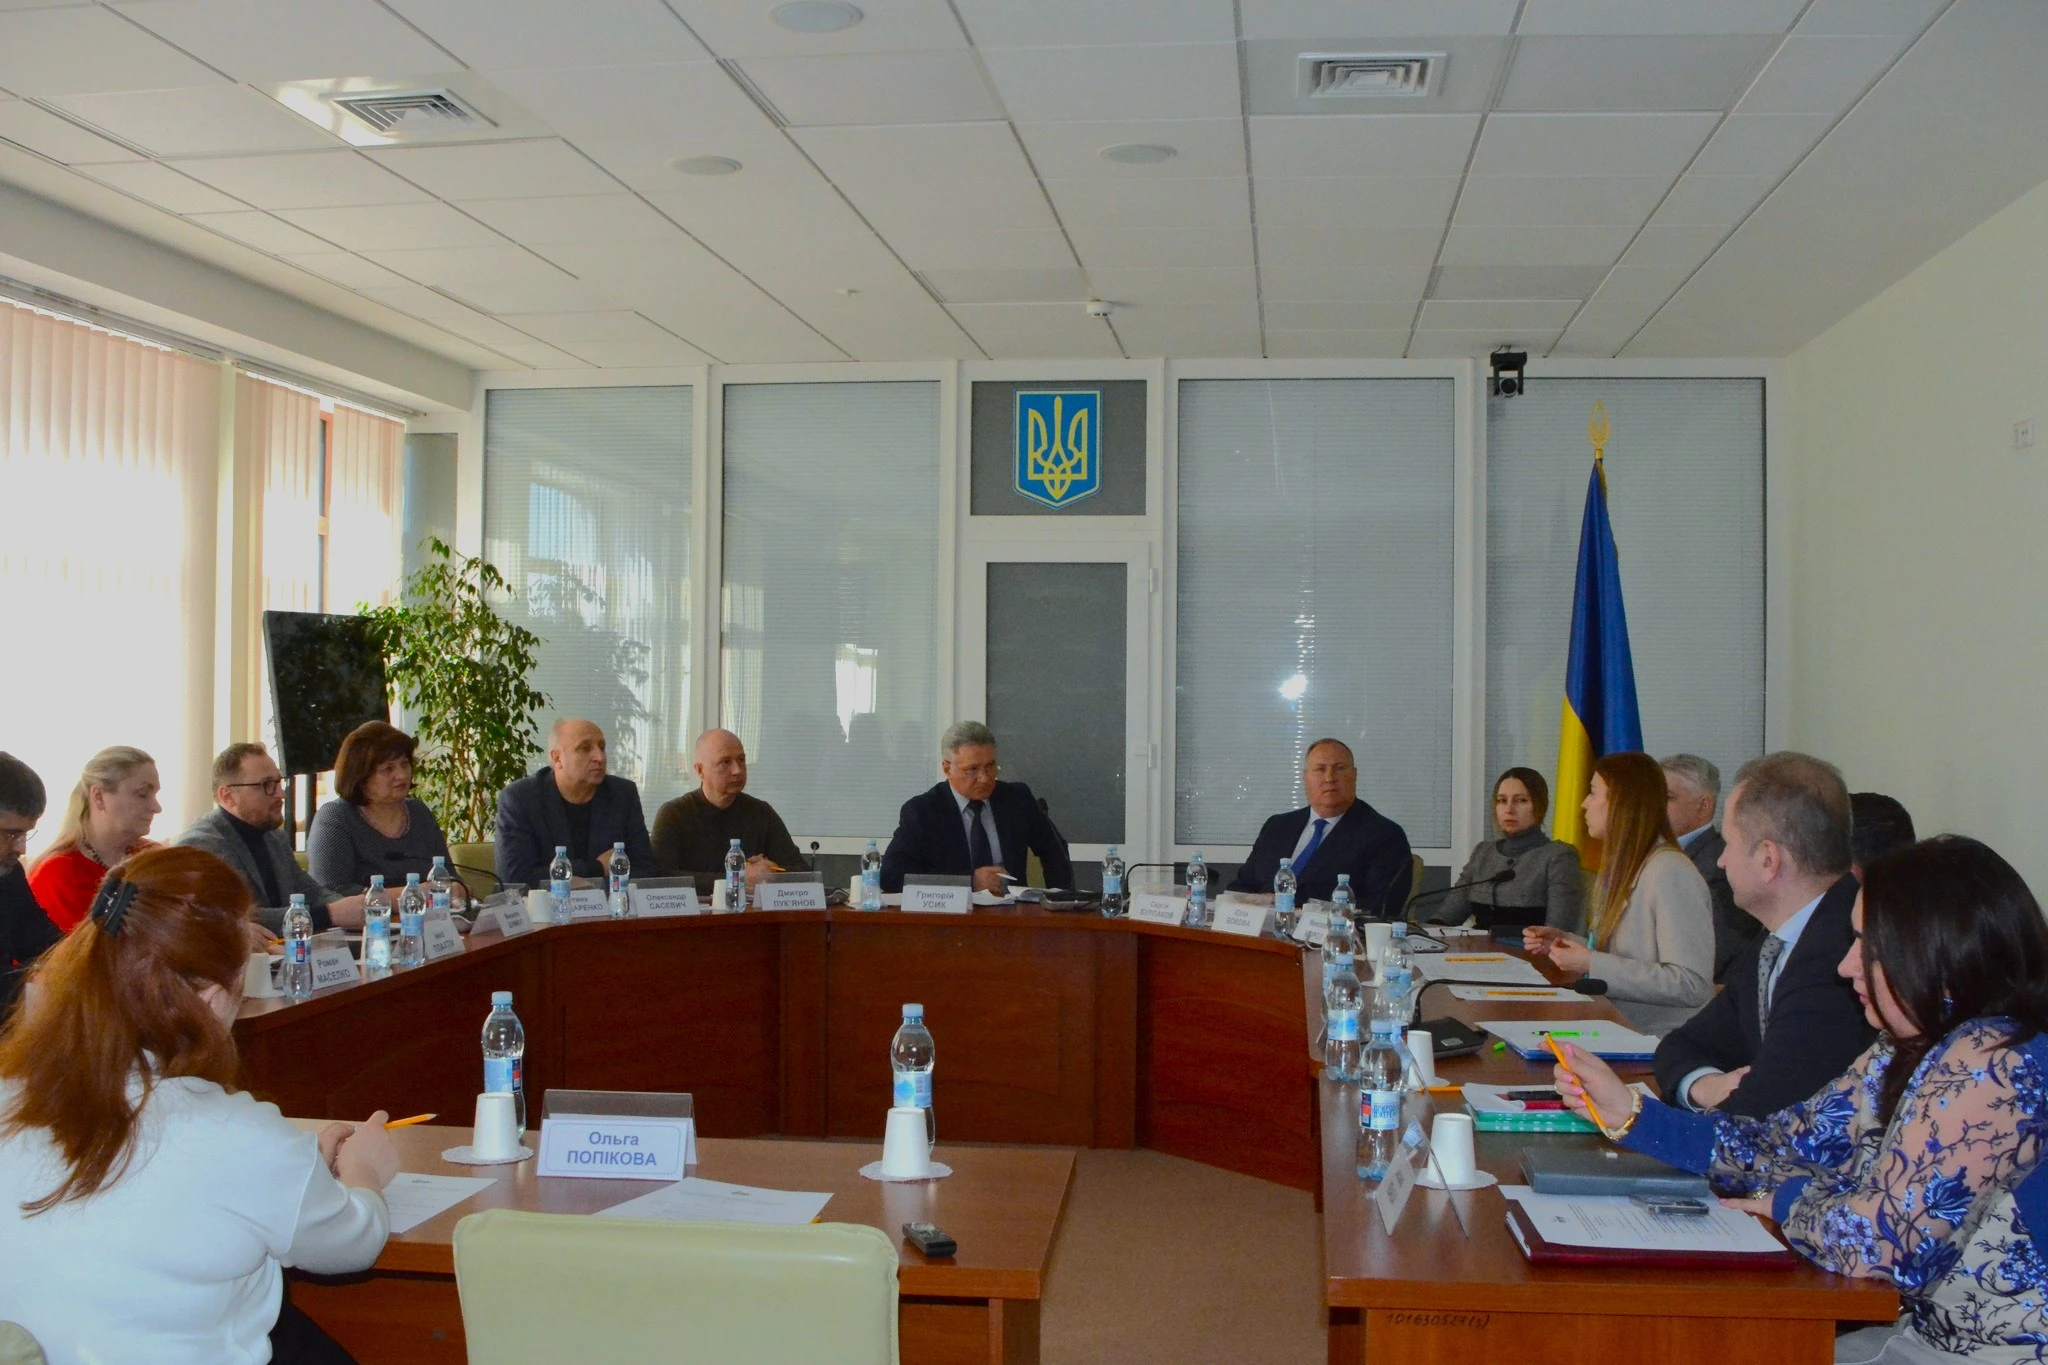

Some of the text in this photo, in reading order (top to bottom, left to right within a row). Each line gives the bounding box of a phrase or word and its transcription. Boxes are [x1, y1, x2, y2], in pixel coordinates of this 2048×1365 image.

[777, 889, 809, 897] Дмитро
[916, 891, 954, 899] Григорій
[649, 902, 687, 910] САСЕВИЧ
[316, 958, 340, 968] Роман
[589, 1131, 640, 1146] Ольга
[566, 1150, 657, 1166] ПОПІКОВА
